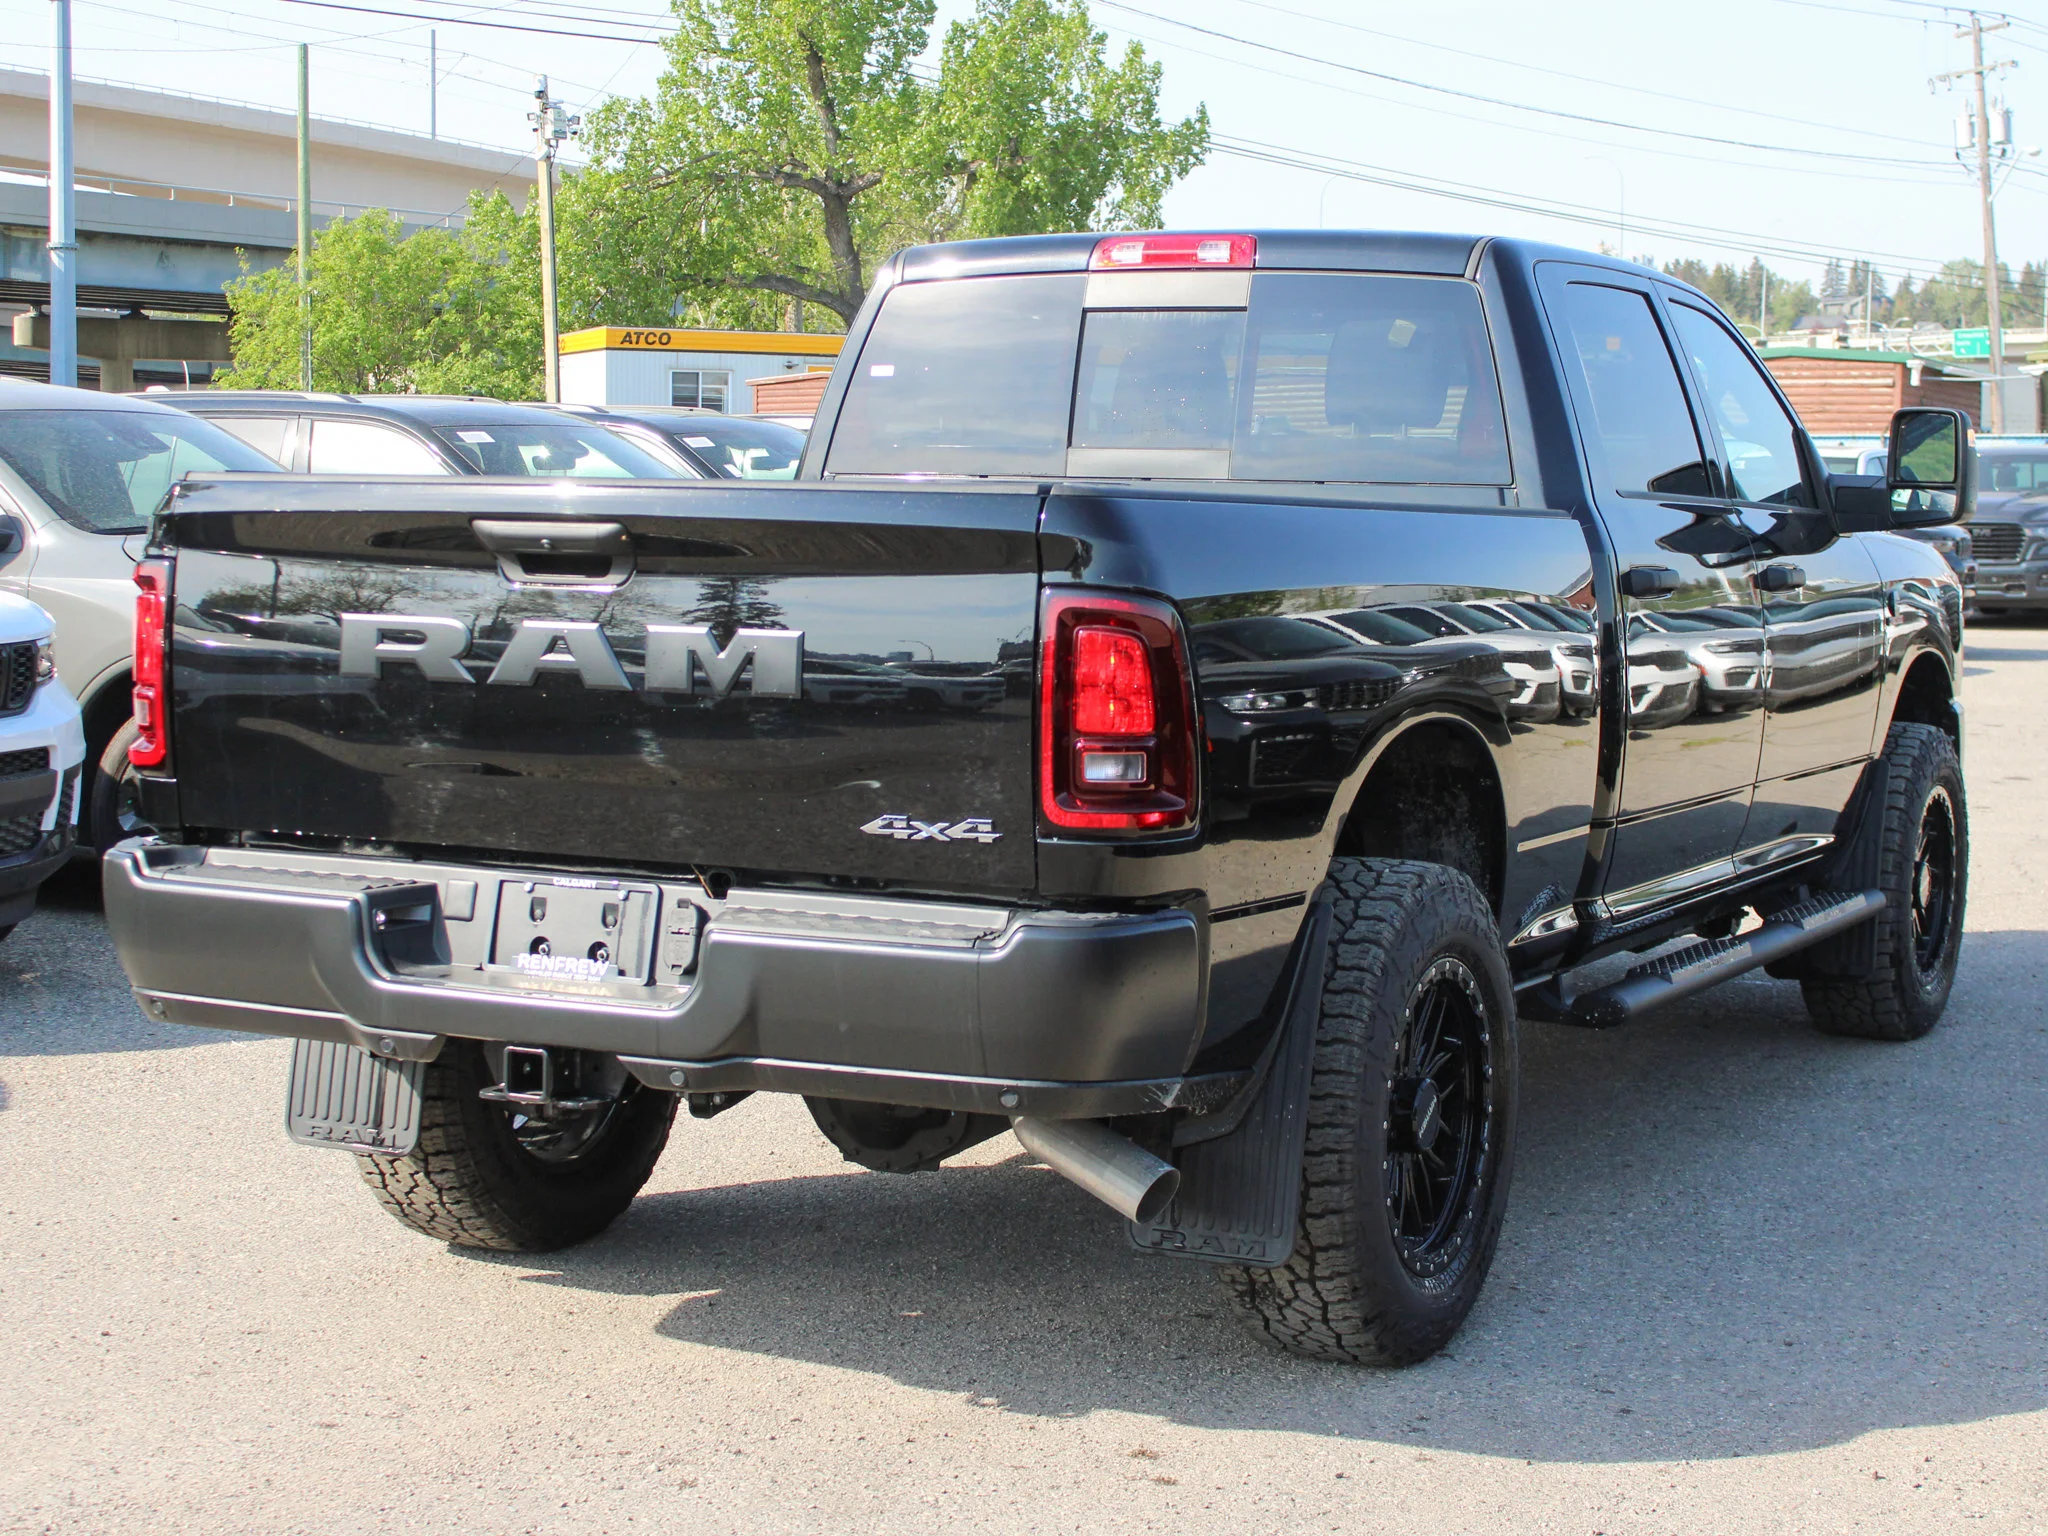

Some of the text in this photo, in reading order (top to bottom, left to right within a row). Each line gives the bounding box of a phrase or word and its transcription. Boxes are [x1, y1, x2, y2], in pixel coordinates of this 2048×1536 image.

[620, 331, 671, 345] ATCO
[340, 613, 804, 698] RAM
[553, 877, 597, 889] CALGARY
[517, 952, 610, 976] RENFREW
[1152, 1227, 1267, 1257] RAM
